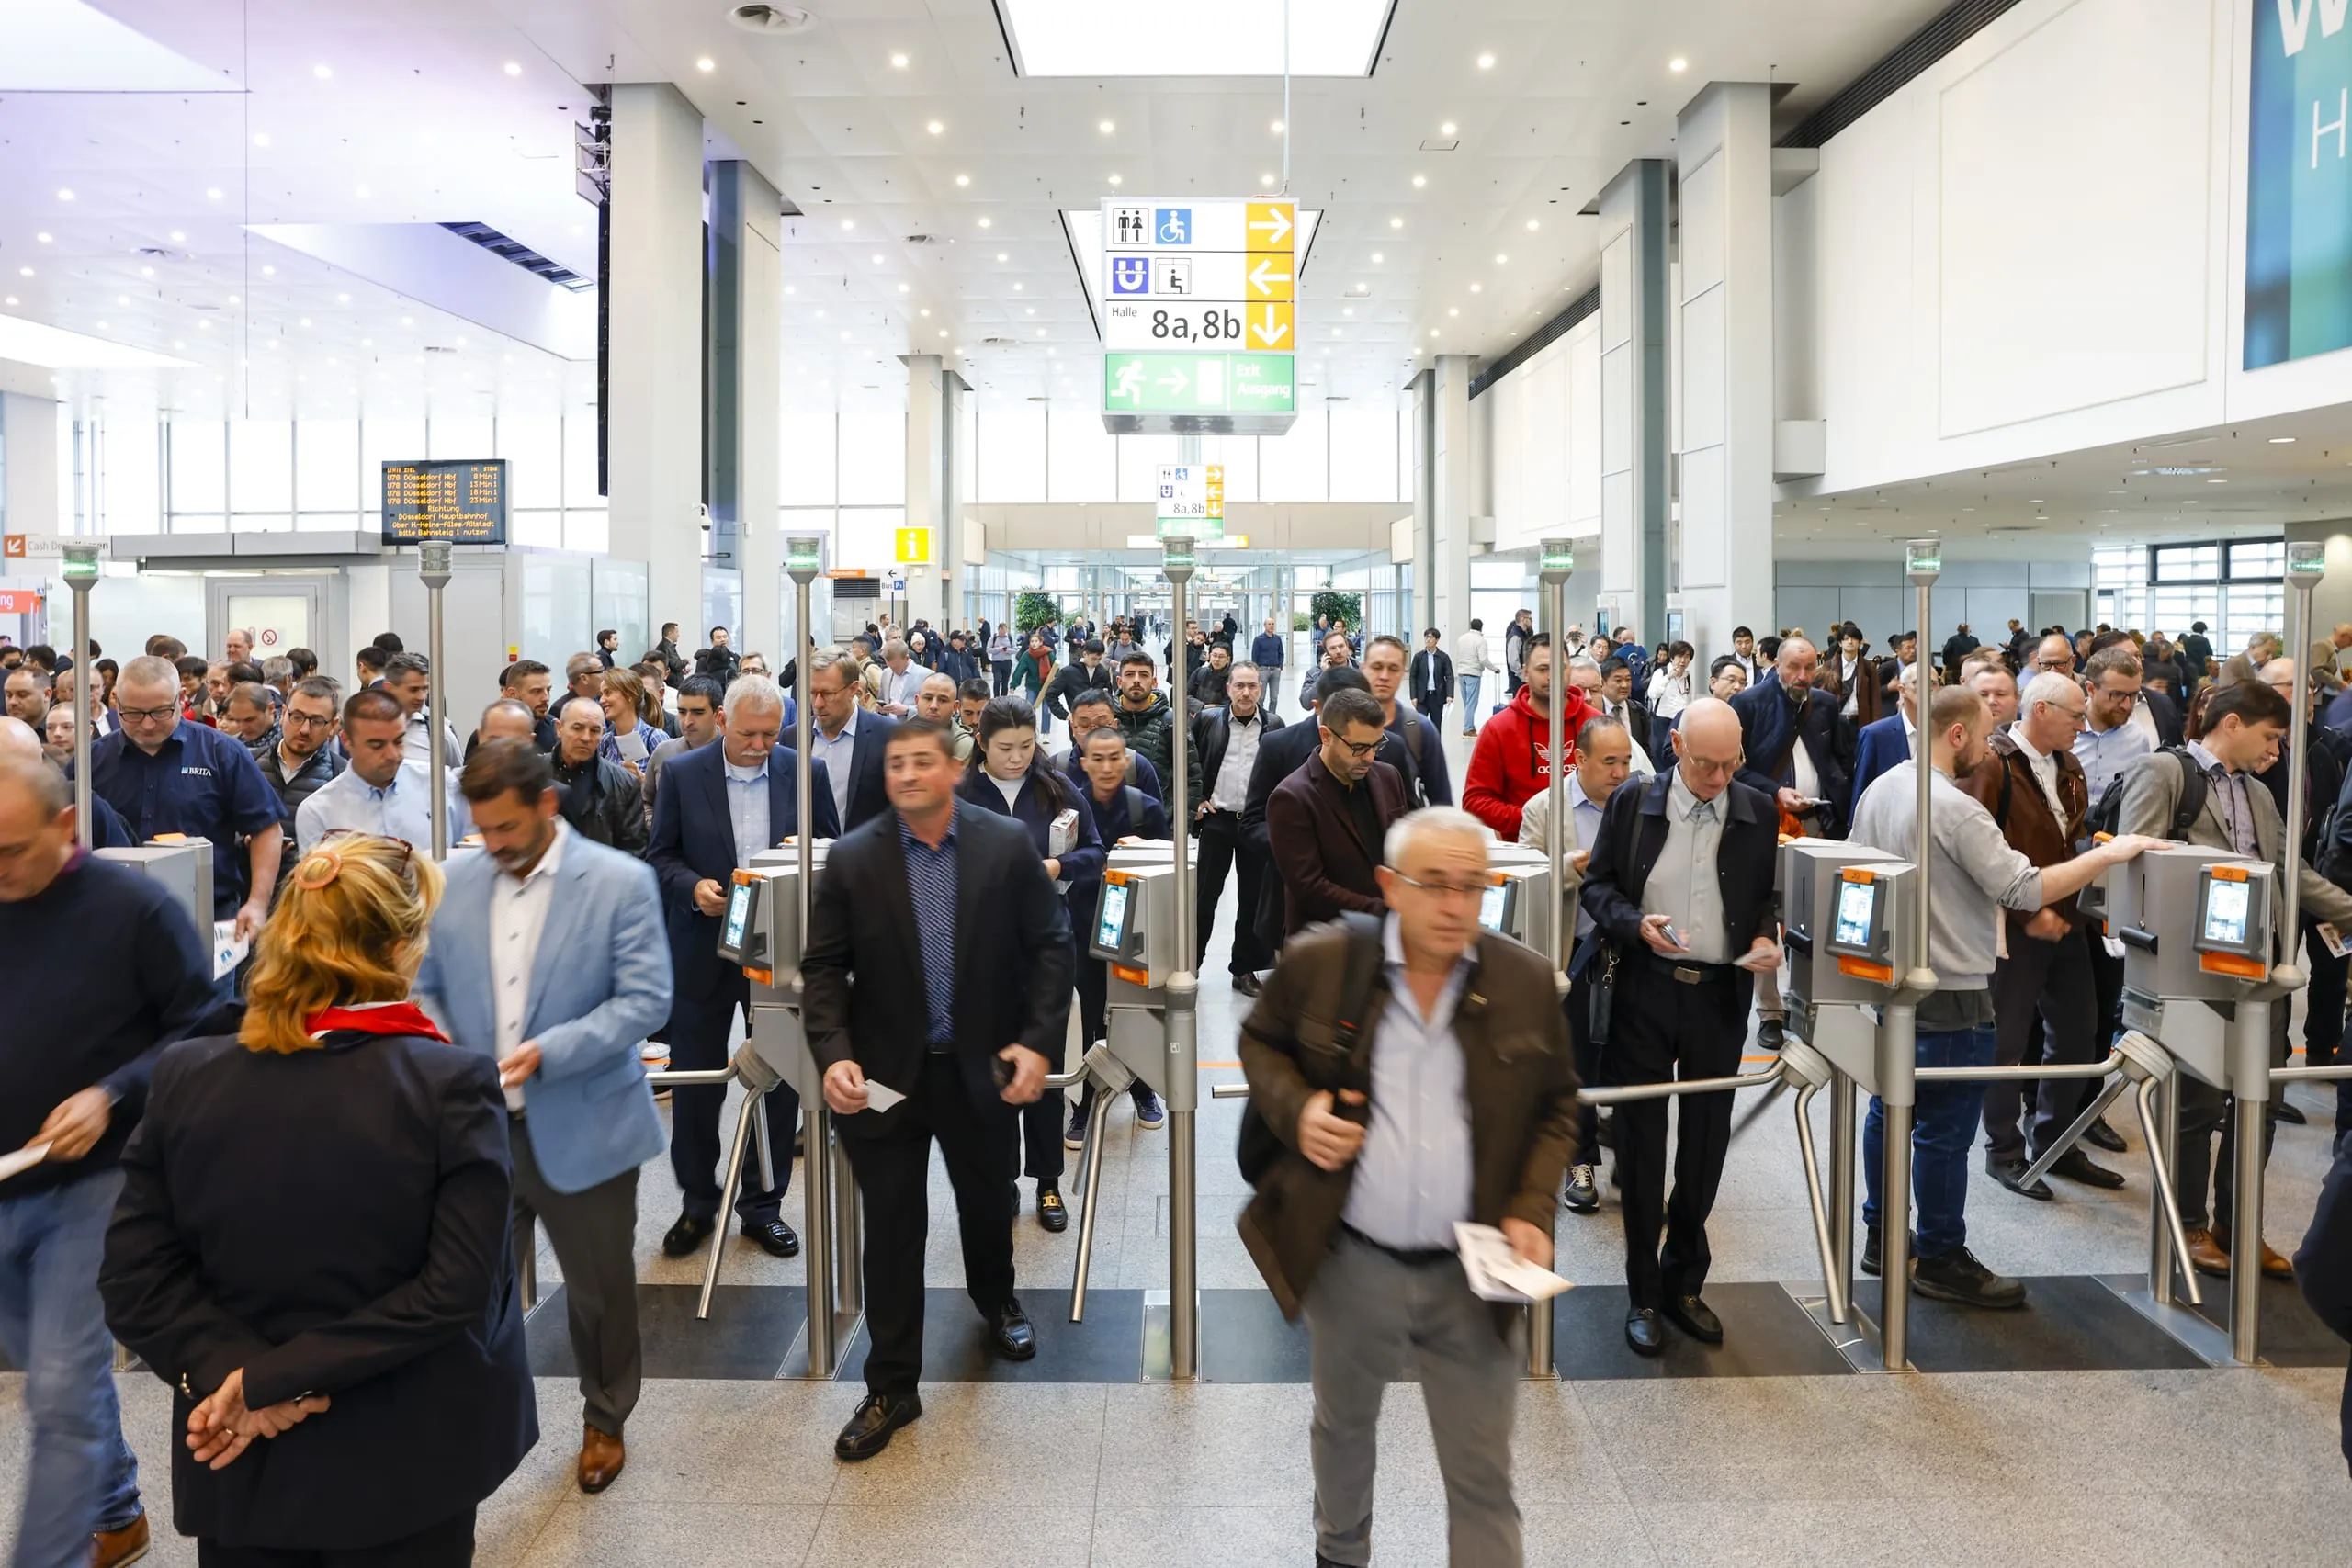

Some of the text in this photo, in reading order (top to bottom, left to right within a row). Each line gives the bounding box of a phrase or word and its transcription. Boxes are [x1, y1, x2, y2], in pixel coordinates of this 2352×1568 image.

[2312, 87, 2347, 169] H
[1112, 306, 1241, 344] Halle 8a,8b
[1236, 362, 1261, 377] Exit
[1236, 381, 1291, 399] Ausgang
[1173, 502, 1205, 514] 8a,8b
[398, 513, 488, 521] Düsseldorf Hauptbahnhof
[28, 540, 49, 550] Cash
[188, 766, 211, 777] BRITA
